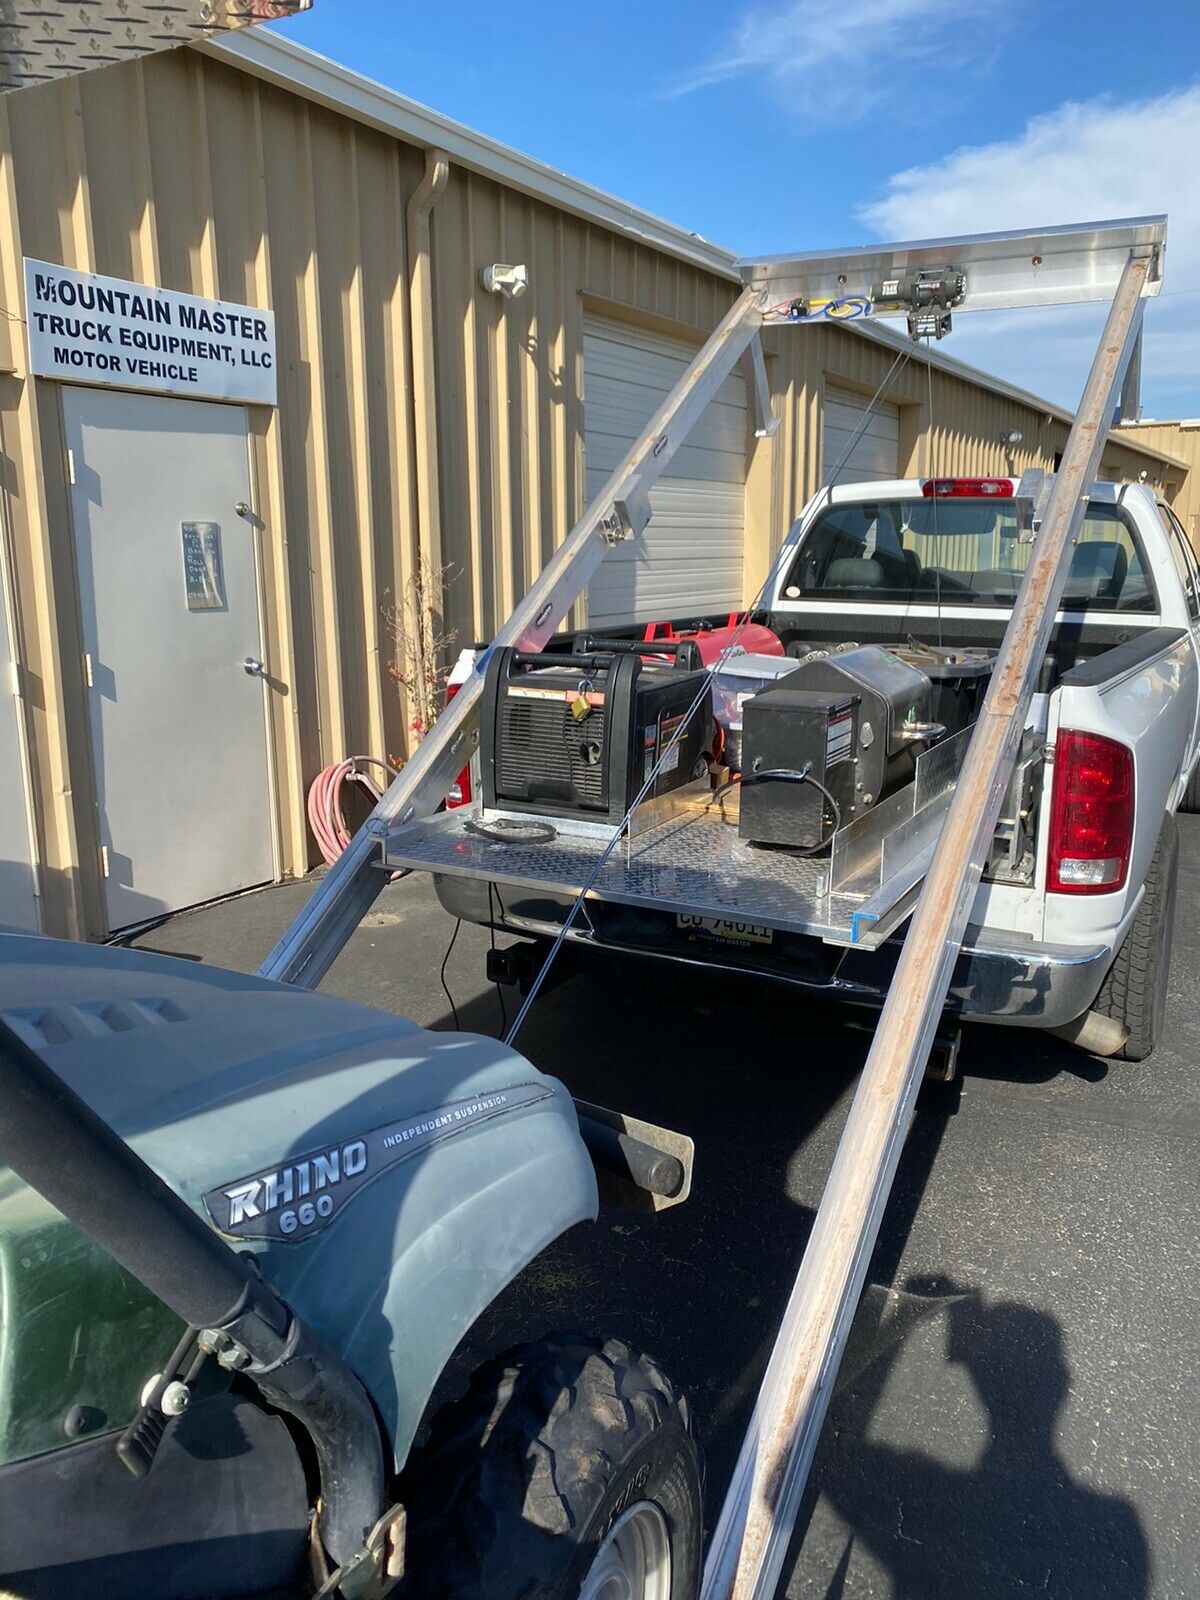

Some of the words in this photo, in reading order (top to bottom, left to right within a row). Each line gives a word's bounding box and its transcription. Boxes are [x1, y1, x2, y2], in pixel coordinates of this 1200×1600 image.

[35, 274, 171, 325] MOUNTAIN
[178, 304, 268, 342] MASTER
[33, 312, 113, 344] TRUCK
[119, 327, 235, 367] EQUIPMENT,
[241, 348, 272, 369] LLC
[54, 346, 121, 372] MOTOR
[126, 358, 199, 382] VEHICLE
[383, 1113, 454, 1149] INDEPENDENT
[454, 1095, 508, 1121] SUSPENSION
[223, 1139, 367, 1227] RHINO
[279, 1194, 334, 1234] 660
